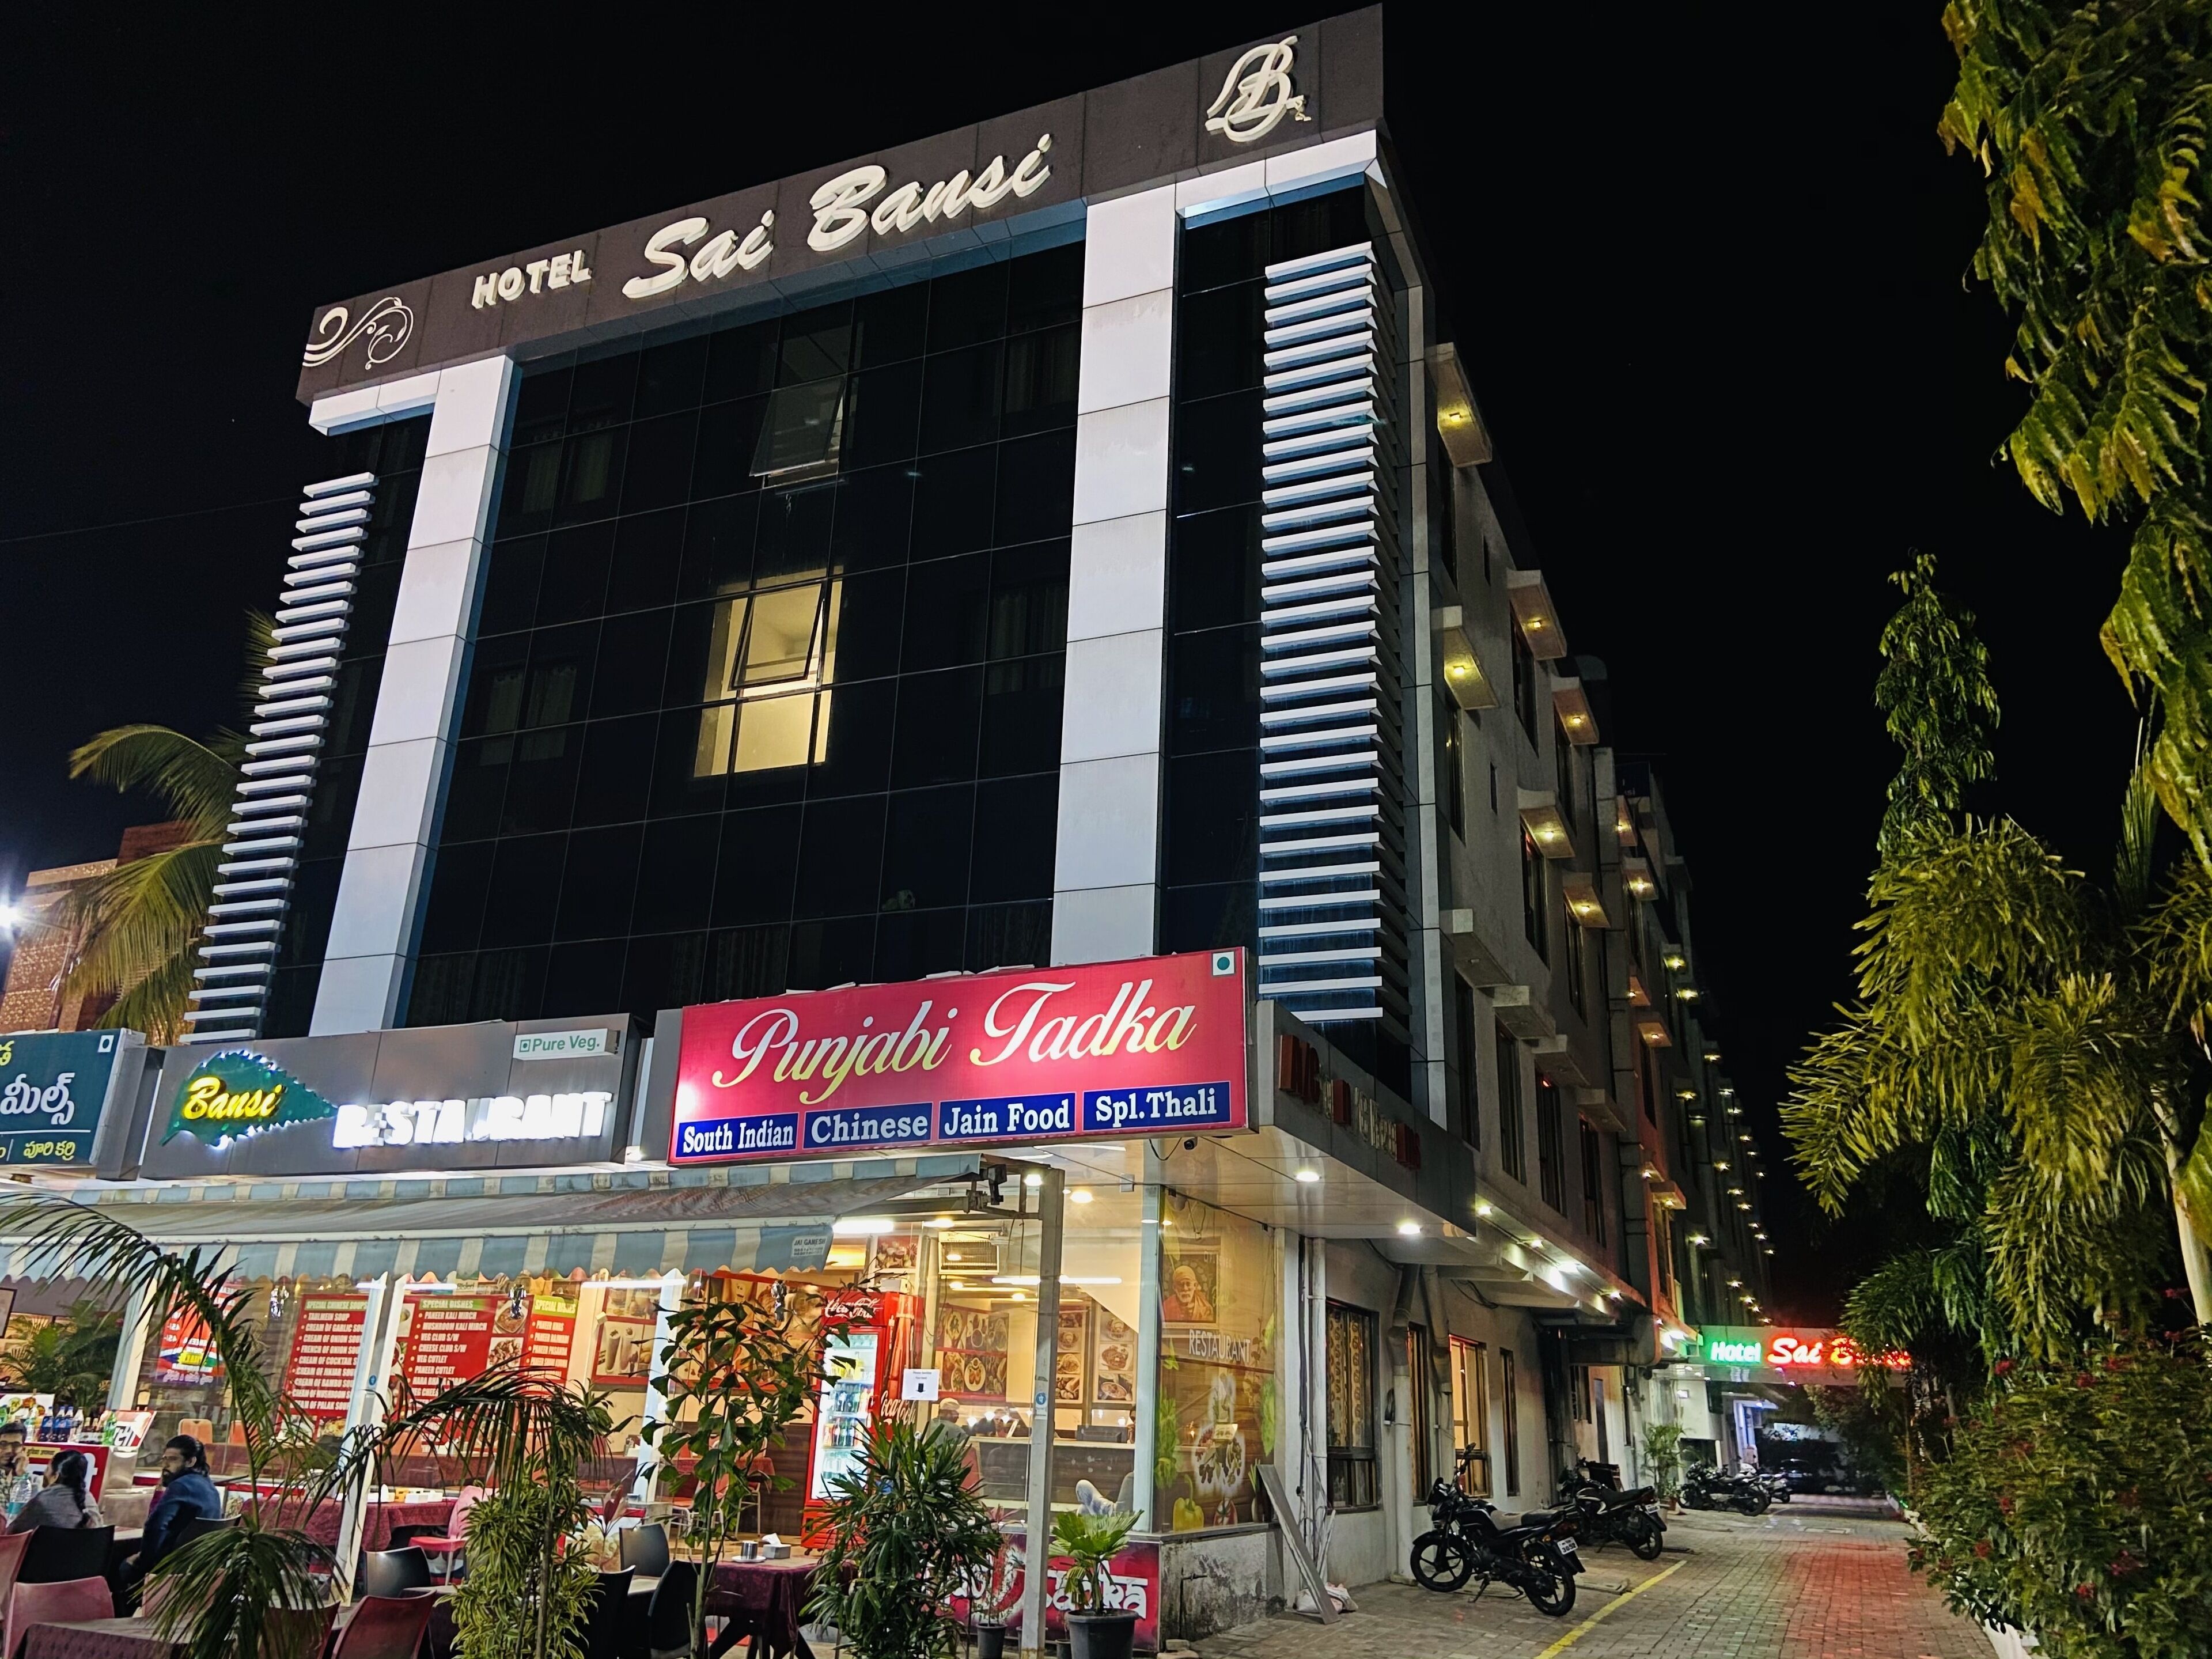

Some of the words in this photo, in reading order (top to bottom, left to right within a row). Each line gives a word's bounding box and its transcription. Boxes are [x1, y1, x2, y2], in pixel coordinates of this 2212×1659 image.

[472, 250, 592, 309] HOTEL
[622, 210, 774, 298] Sai
[807, 132, 1052, 252] Bansi
[532, 1039, 565, 1051] Pure
[569, 1035, 600, 1051] Veg.
[711, 999, 959, 1105] Punjabi
[969, 978, 1197, 1067] Tadka
[184, 1077, 283, 1119] Bansi
[333, 1092, 612, 1148] RESTAURANT
[945, 1105, 999, 1136] Jain
[1007, 1098, 1070, 1131] Food
[811, 1112, 927, 1143] Chinese
[683, 1123, 733, 1153] South
[738, 1119, 793, 1149] Indian
[422, 1300, 448, 1308] SPECIAL
[449, 1300, 474, 1308] DISHES
[535, 1300, 556, 1312] SPECIAL
[334, 1313, 350, 1321] SOUP
[332, 1324, 353, 1332] GARLIC
[322, 1335, 330, 1343] OF
[421, 1333, 432, 1341] VEG
[431, 1333, 446, 1342] CLUB
[322, 1345, 330, 1354] OF
[418, 1344, 439, 1352] CHEESE
[439, 1344, 454, 1353] CLUB
[1189, 1329, 1251, 1362] RESTAURANT
[1711, 1341, 1761, 1363] Hotel
[1767, 1338, 1823, 1364] Sai
[318, 1357, 326, 1365] OF
[325, 1357, 353, 1365] COCKTAIL
[416, 1355, 428, 1363] VEG
[427, 1355, 448, 1363] CUTLET
[414, 1366, 435, 1374] PANEER
[435, 1366, 456, 1374] CUTLET
[309, 1400, 318, 1409] OF
[317, 1401, 335, 1410] PALAK
[1562, 1543, 1576, 1553] 3052
